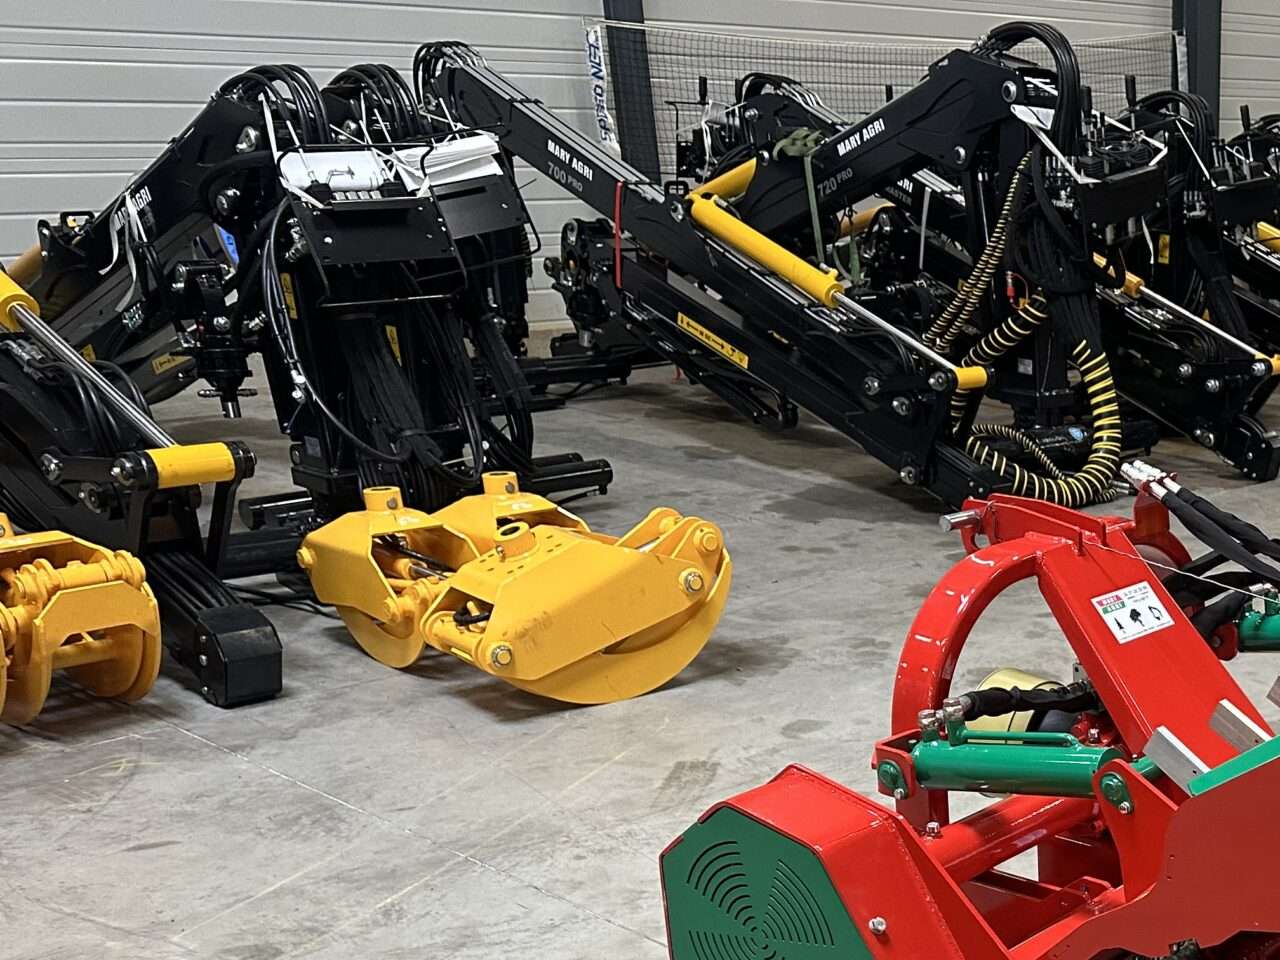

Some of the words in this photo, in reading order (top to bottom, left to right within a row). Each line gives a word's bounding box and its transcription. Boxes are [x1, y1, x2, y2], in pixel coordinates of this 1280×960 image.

[836, 131, 861, 156] MARY
[862, 118, 885, 141] AGRI
[547, 139, 571, 164] MARY
[571, 156, 593, 181] AGRI
[547, 161, 567, 184] 700
[567, 174, 583, 192] PRO
[817, 177, 837, 197] 720
[837, 167, 853, 184] PRO
